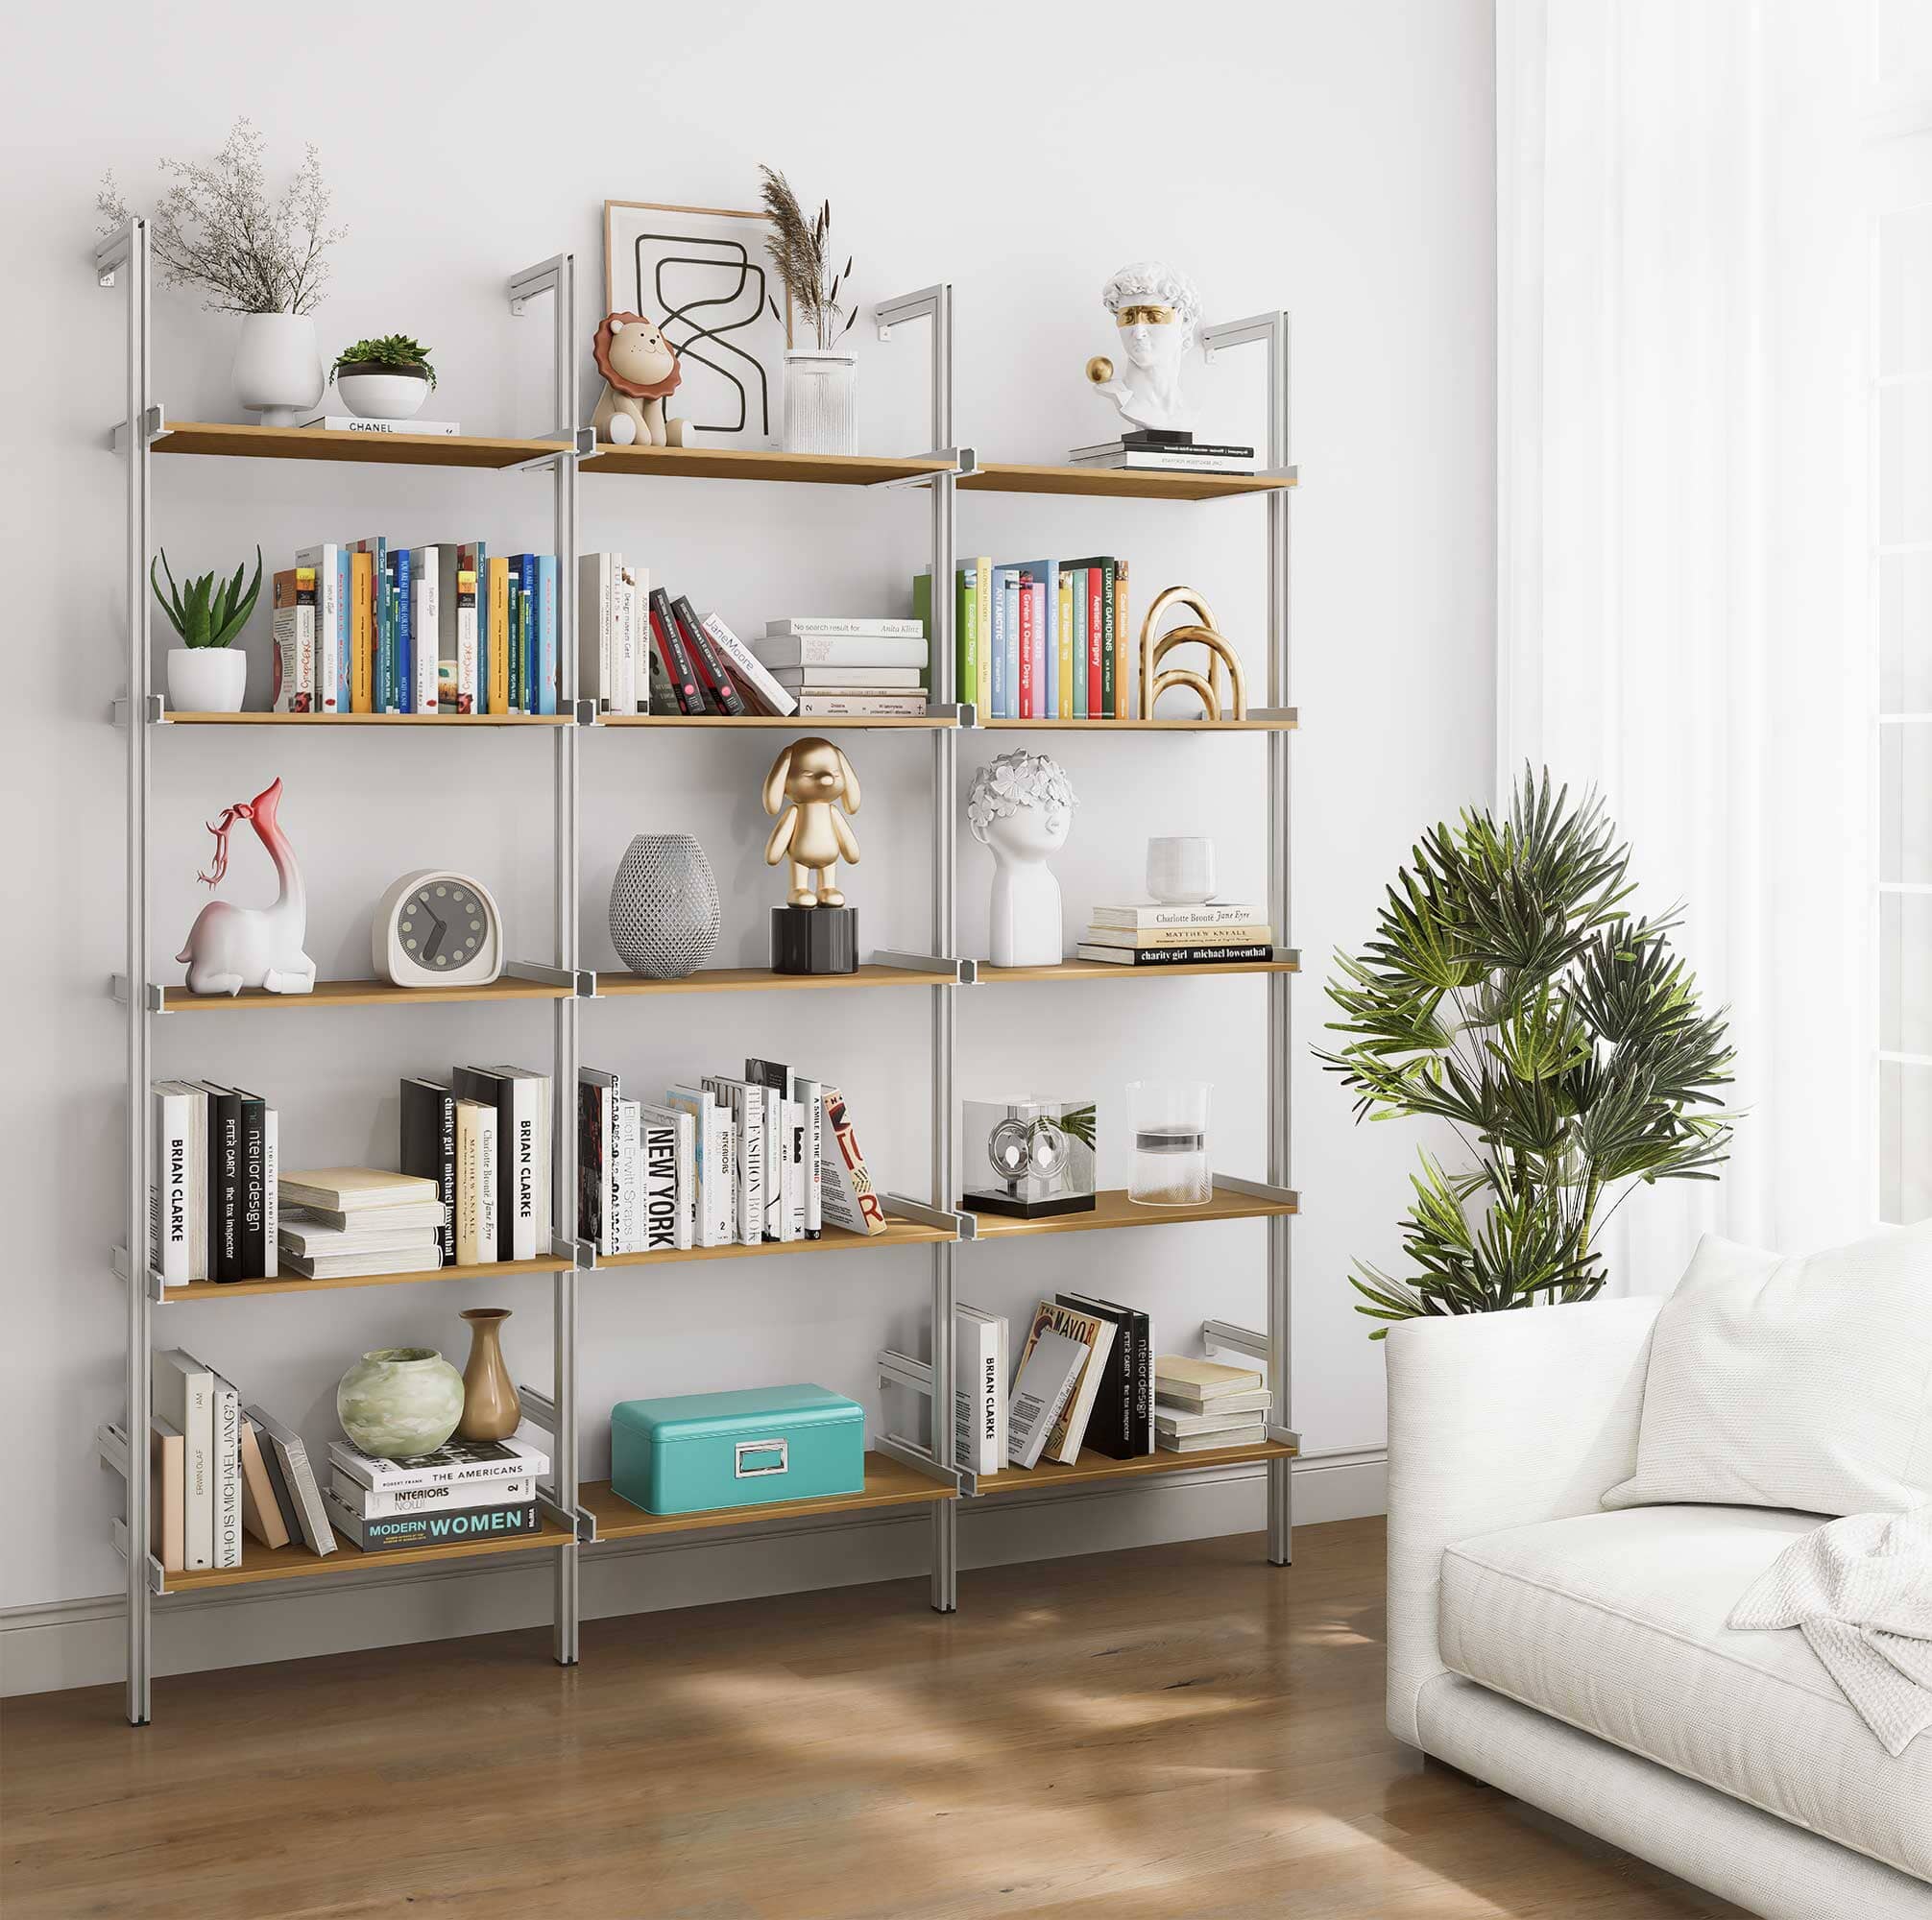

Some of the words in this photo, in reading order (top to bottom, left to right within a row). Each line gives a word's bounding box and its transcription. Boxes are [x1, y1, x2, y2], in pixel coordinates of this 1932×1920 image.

[349, 422, 393, 432] CHANEL
[806, 624, 827, 632] search
[995, 588, 1004, 640] ANTARCTIC
[967, 641, 976, 666] Design
[1091, 632, 1100, 666] Surgery
[1022, 664, 1031, 689] Design
[1156, 914, 1189, 923] Charlotte
[1216, 911, 1233, 921] Jane
[1234, 910, 1250, 920] Eyre
[1141, 951, 1171, 962] charity
[1172, 950, 1188, 961] girl
[1193, 948, 1225, 959] michael
[1226, 948, 1266, 958] lowenthal
[443, 1098, 454, 1135] charity
[748, 1087, 760, 1122] THE
[226, 1119, 235, 1146] PETER
[624, 1106, 636, 1142] Elliott
[814, 1132, 820, 1141] IN
[443, 1137, 454, 1156] girl
[483, 1129, 492, 1167] Charlotte
[520, 1121, 531, 1163] BRIAN
[648, 1129, 675, 1178] NEW
[748, 1125, 760, 1192] FASHION
[171, 1139, 183, 1185] BRIAN
[226, 1149, 235, 1178] CAREY
[624, 1147, 636, 1186] Erwitt
[226, 1187, 235, 1201] the
[445, 1163, 454, 1203] michael
[520, 1167, 531, 1218] CLARKE
[171, 1187, 183, 1242] CLARKE
[484, 1200, 494, 1221] Jane
[622, 1190, 636, 1236] Snaps
[648, 1186, 675, 1248] YORK
[720, 1222, 725, 1231] 2
[748, 1197, 760, 1242] BOOK
[445, 1205, 454, 1256] lowenthal
[483, 1222, 495, 1240] Eyre
[986, 1357, 995, 1394] BRIAN
[196, 1392, 203, 1405] AM
[224, 1404, 235, 1449] JANG?
[986, 1397, 995, 1440] CLARKE
[224, 1450, 235, 1512] MICHAEL
[433, 1472, 454, 1482] THE
[458, 1464, 523, 1479] AMERICANS
[507, 1484, 518, 1492] 2
[395, 1488, 449, 1501] INTERIORS
[224, 1514, 235, 1527] IS
[370, 1520, 427, 1536] MODERN
[430, 1510, 522, 1536] WOMEN
[224, 1531, 235, 1567] WHO
